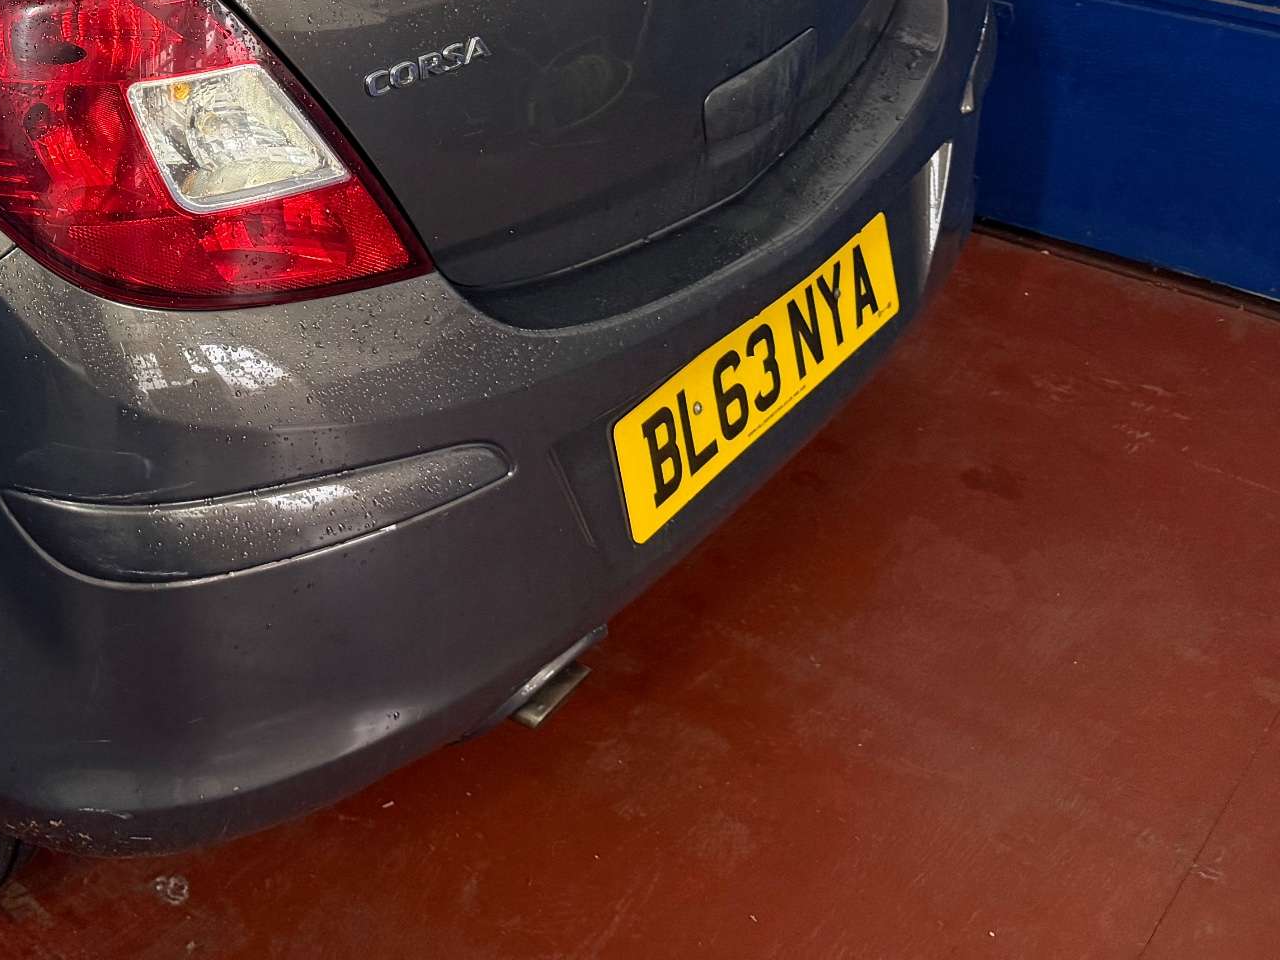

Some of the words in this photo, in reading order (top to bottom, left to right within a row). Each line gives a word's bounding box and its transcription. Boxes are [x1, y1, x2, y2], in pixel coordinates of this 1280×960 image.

[363, 35, 493, 97] CORSA
[641, 323, 781, 509] BL63
[786, 243, 879, 381] NYA
